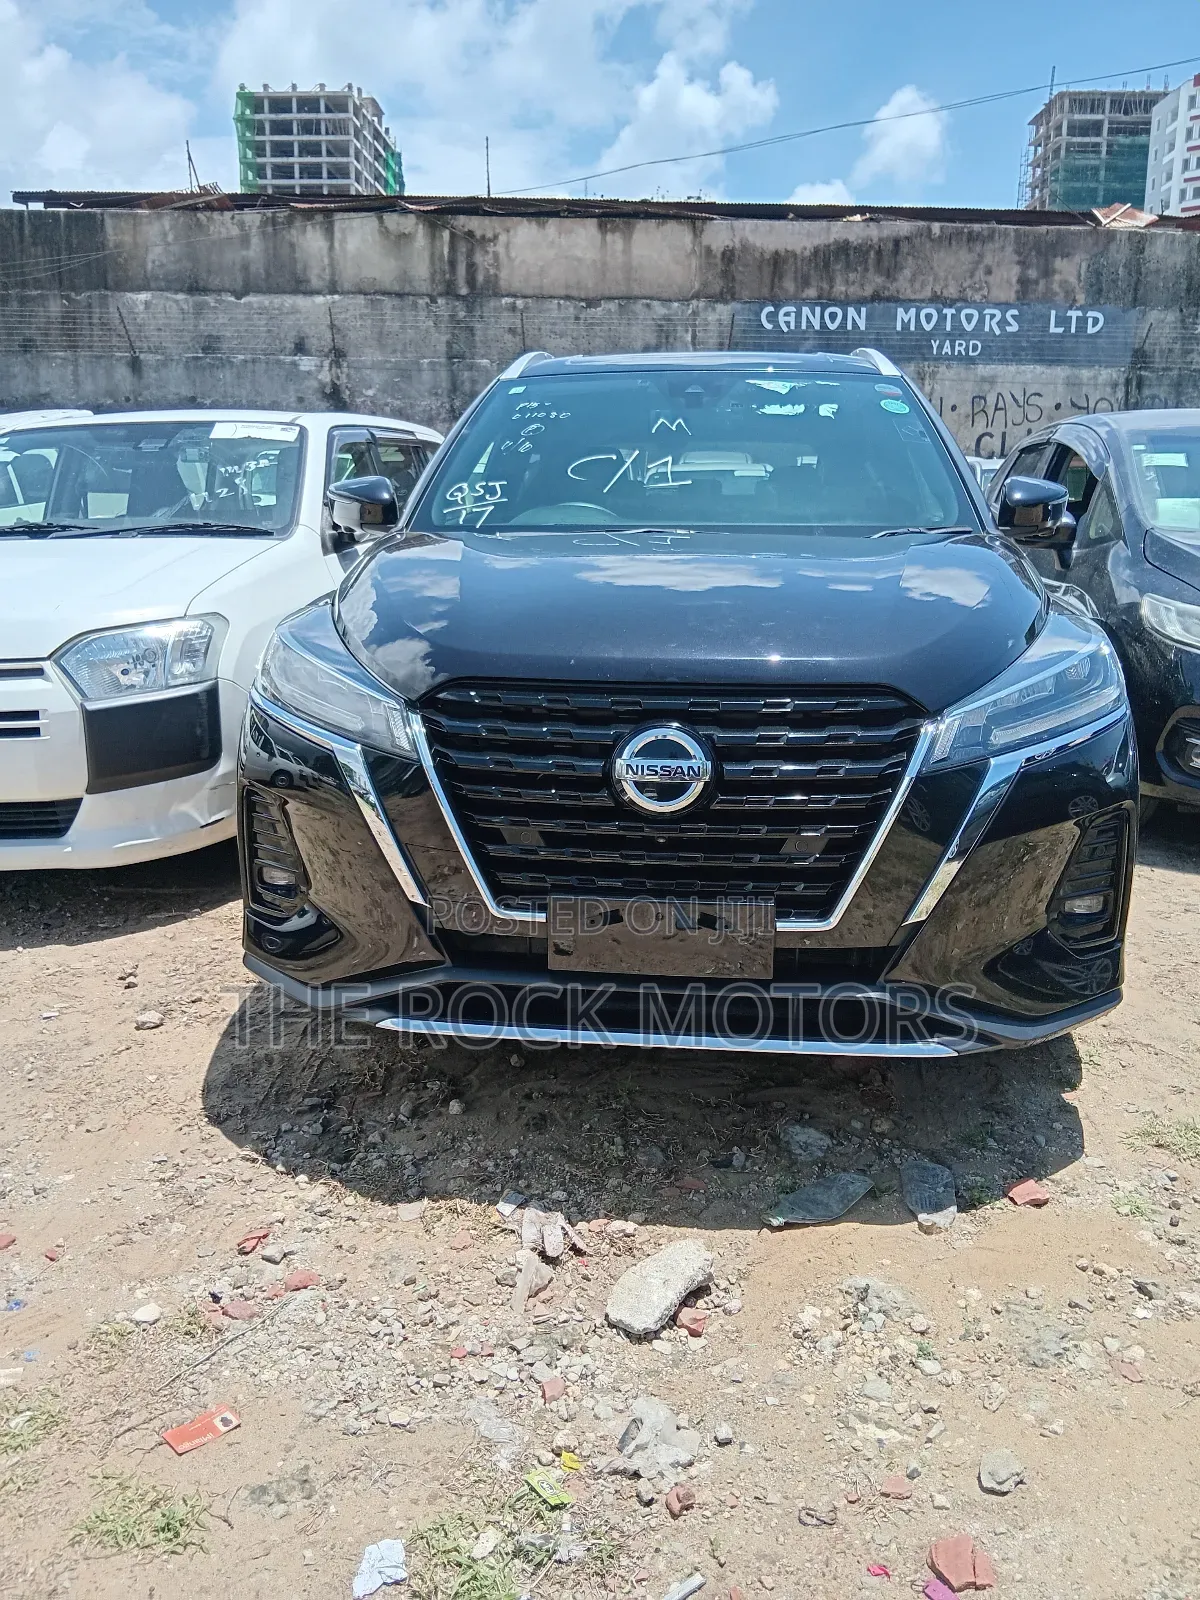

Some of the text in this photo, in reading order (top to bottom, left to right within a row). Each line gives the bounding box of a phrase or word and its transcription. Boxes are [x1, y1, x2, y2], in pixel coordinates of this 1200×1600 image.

[761, 306, 1104, 336] CANON MOTORS LTD
[930, 339, 982, 356] YARD
[971, 387, 1044, 430] RAYS
[625, 763, 701, 778] NISSAN
